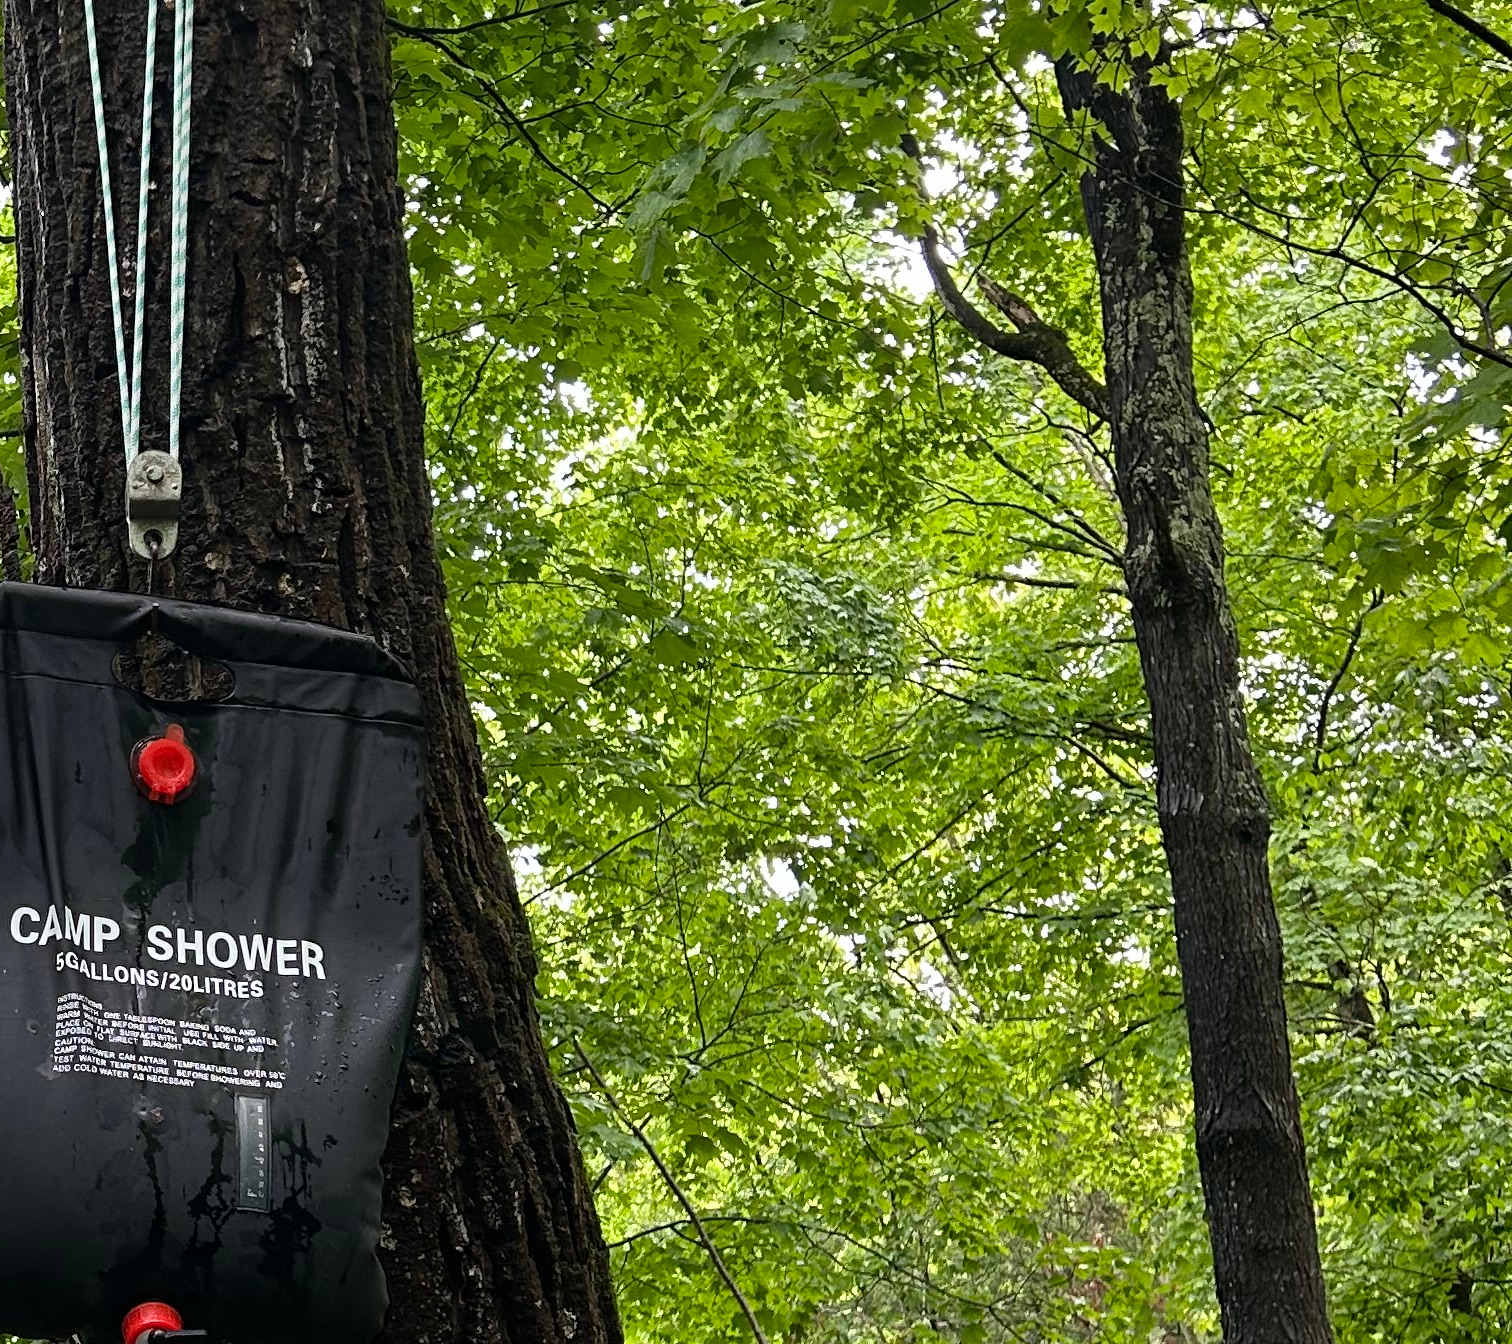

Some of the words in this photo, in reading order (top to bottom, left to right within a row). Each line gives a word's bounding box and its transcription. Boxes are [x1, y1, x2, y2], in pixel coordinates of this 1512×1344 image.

[10, 905, 120, 952] CAMP
[147, 925, 326, 979] SHOWER
[56, 1020, 80, 1029] PLACE
[97, 1026, 114, 1034] FLAT
[119, 1029, 156, 1039] SURFACE
[157, 1033, 177, 1042] WITH
[182, 1038, 208, 1047] BLACK
[56, 1027, 92, 1037] EXPOSED
[94, 1032, 104, 1040] TO
[108, 1036, 138, 1044] DIRECT
[57, 1011, 80, 1019] WARM
[83, 1013, 108, 1025] WATER
[112, 1021, 144, 1030] BEFORE
[223, 1035, 244, 1043] WITH
[124, 1014, 176, 1026] TABLESPOON
[179, 1021, 209, 1031] BAKING
[214, 1025, 236, 1035] SODA
[54, 1045, 77, 1054] CAMP
[81, 1046, 115, 1058] SHOWER
[119, 1053, 136, 1061] CAN
[139, 1056, 167, 1065] ATTAIN
[173, 1060, 238, 1075] TEMPERATURES
[54, 1055, 74, 1063] TEST
[79, 1055, 106, 1066] WATER
[110, 1061, 169, 1075] TEMPERATURE
[177, 1070, 209, 1080] BEFORE
[210, 1074, 260, 1086] SHOWERING
[265, 1080, 283, 1088] AND
[74, 1064, 97, 1073] COLD
[99, 1068, 129, 1078] WATER
[146, 1074, 195, 1087] NECESSARY
